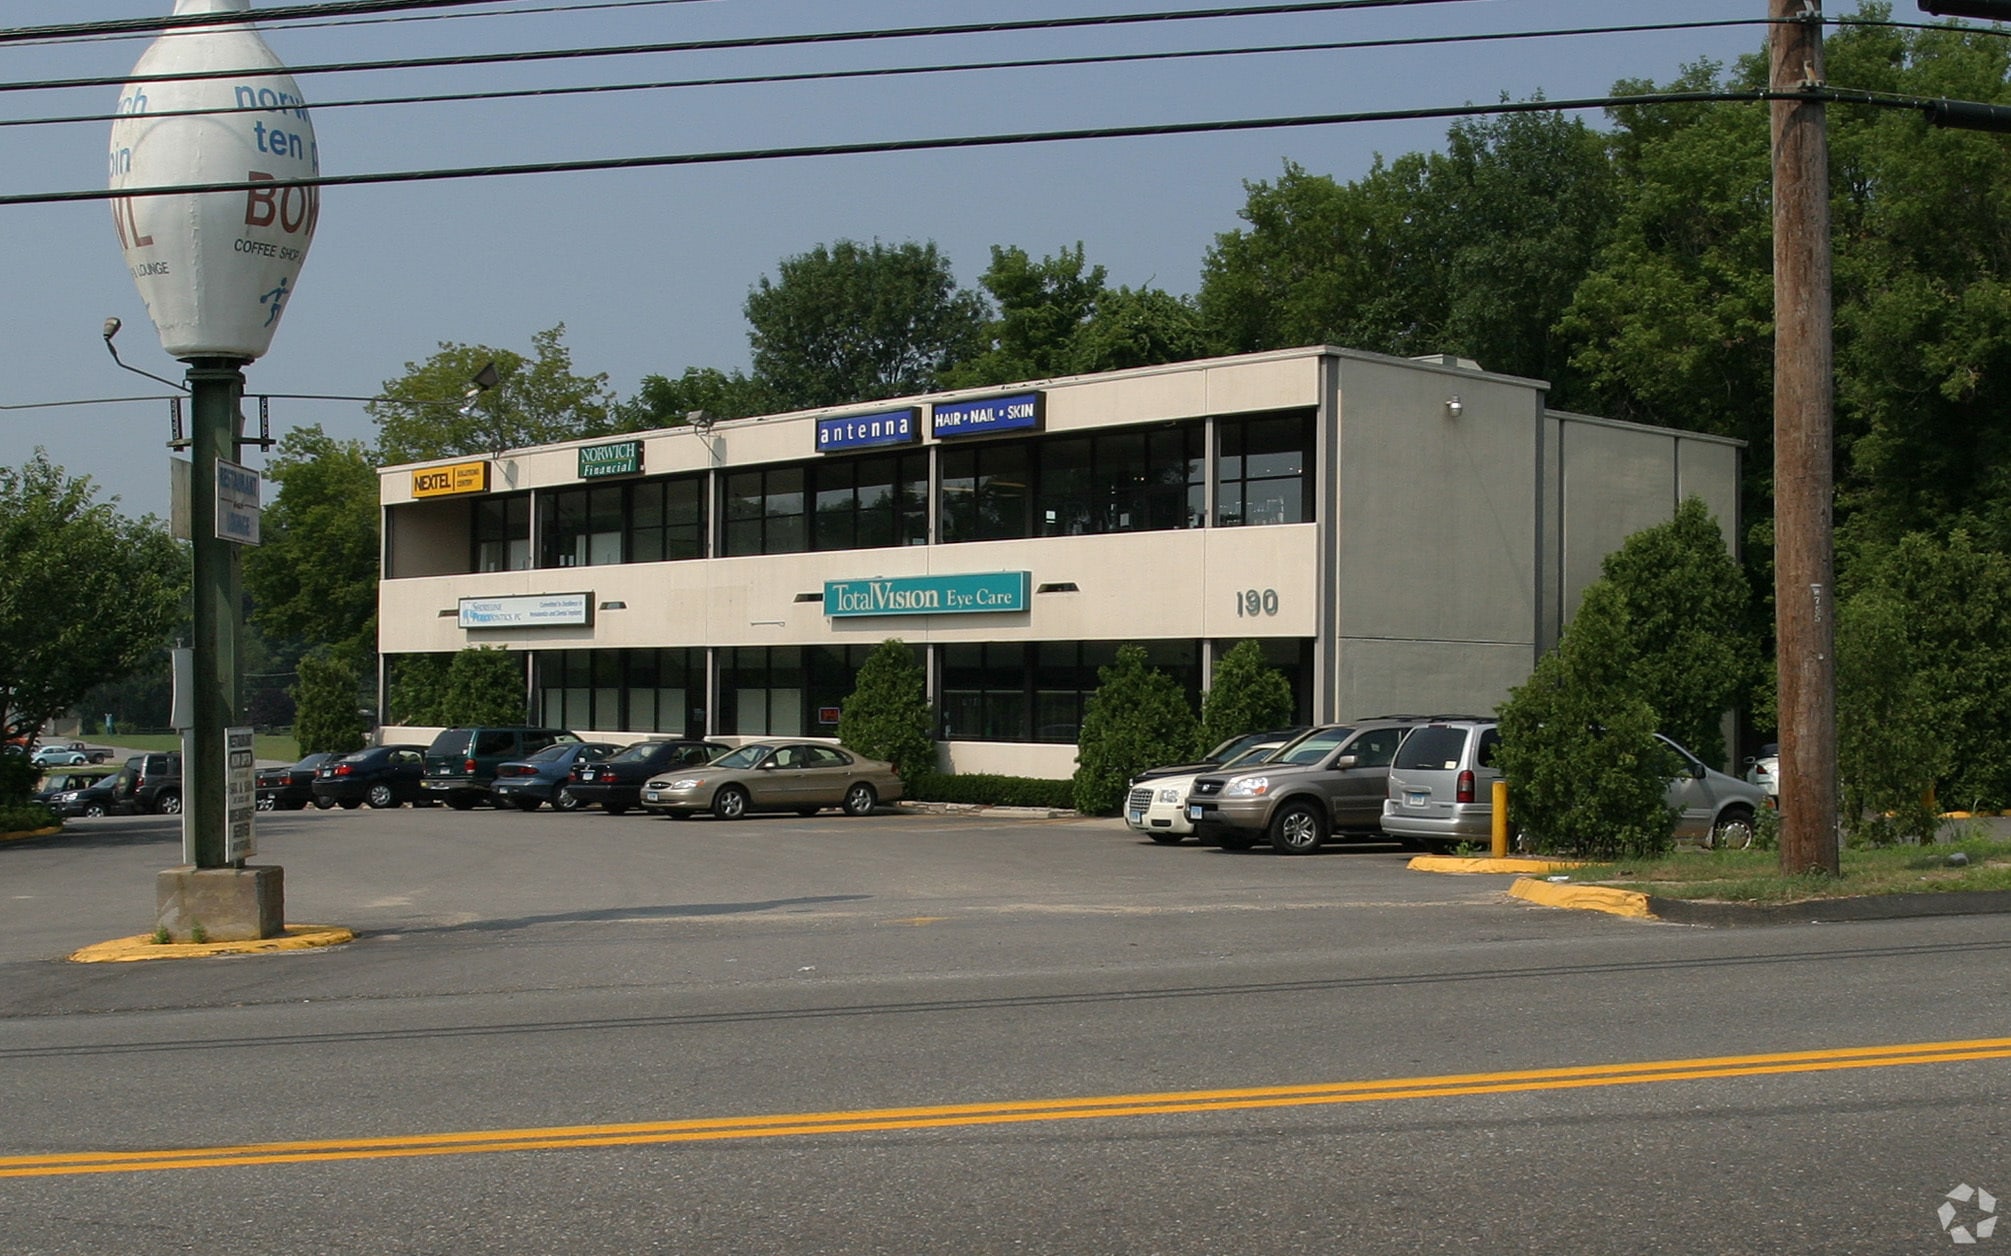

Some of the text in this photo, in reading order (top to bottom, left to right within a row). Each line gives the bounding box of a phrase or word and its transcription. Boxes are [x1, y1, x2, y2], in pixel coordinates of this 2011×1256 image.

[253, 121, 303, 160] ten
[234, 238, 300, 261] COFFEE SHOP
[935, 403, 1034, 428] HAIR NAIL SKIN
[820, 416, 909, 444] antenna
[581, 442, 635, 463] NORWICH
[584, 459, 632, 476] Financial
[414, 473, 451, 492] NEXTEL
[946, 591, 972, 607] Eye
[976, 588, 1012, 605] Care
[1236, 589, 1279, 617] 190
